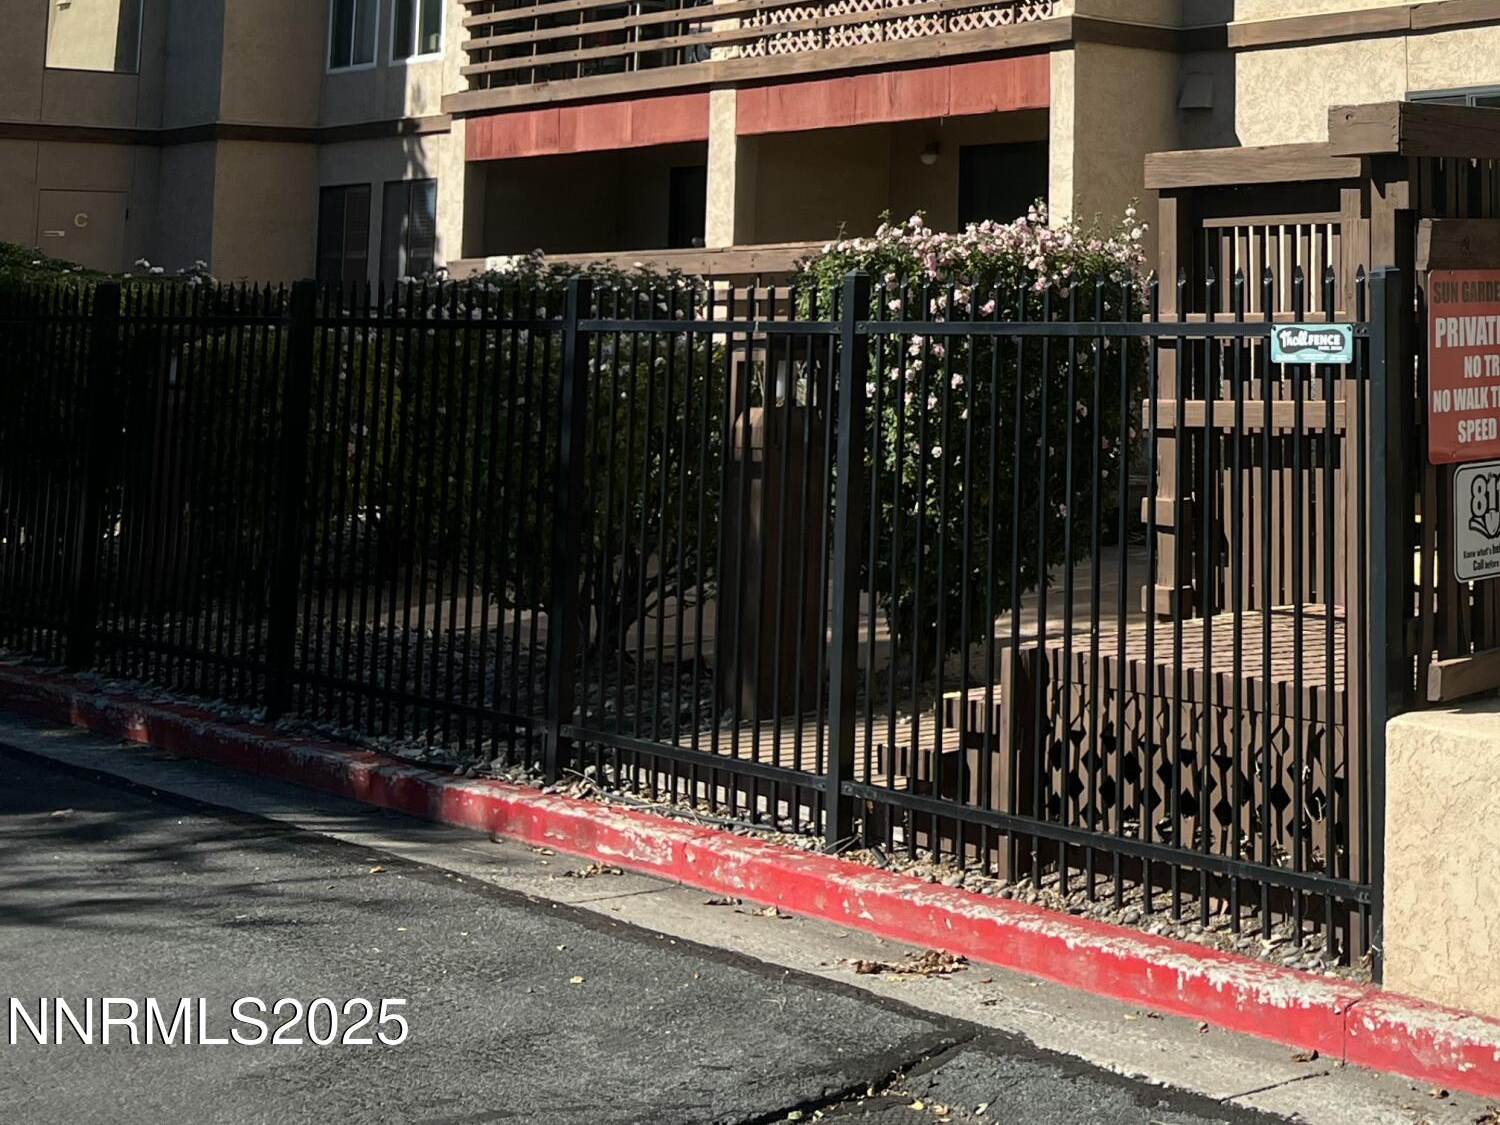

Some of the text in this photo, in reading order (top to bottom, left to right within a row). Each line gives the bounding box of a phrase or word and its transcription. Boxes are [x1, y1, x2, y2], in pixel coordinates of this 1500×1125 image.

[74, 212, 88, 228] C
[1433, 281, 1459, 304] SUN
[1307, 334, 1341, 346] FENCE
[1463, 355, 1482, 379] NO
[1433, 389, 1451, 413] NO
[1453, 386, 1489, 411] WALK
[1458, 417, 1497, 444] SPEED
[1473, 559, 1485, 571] Call
